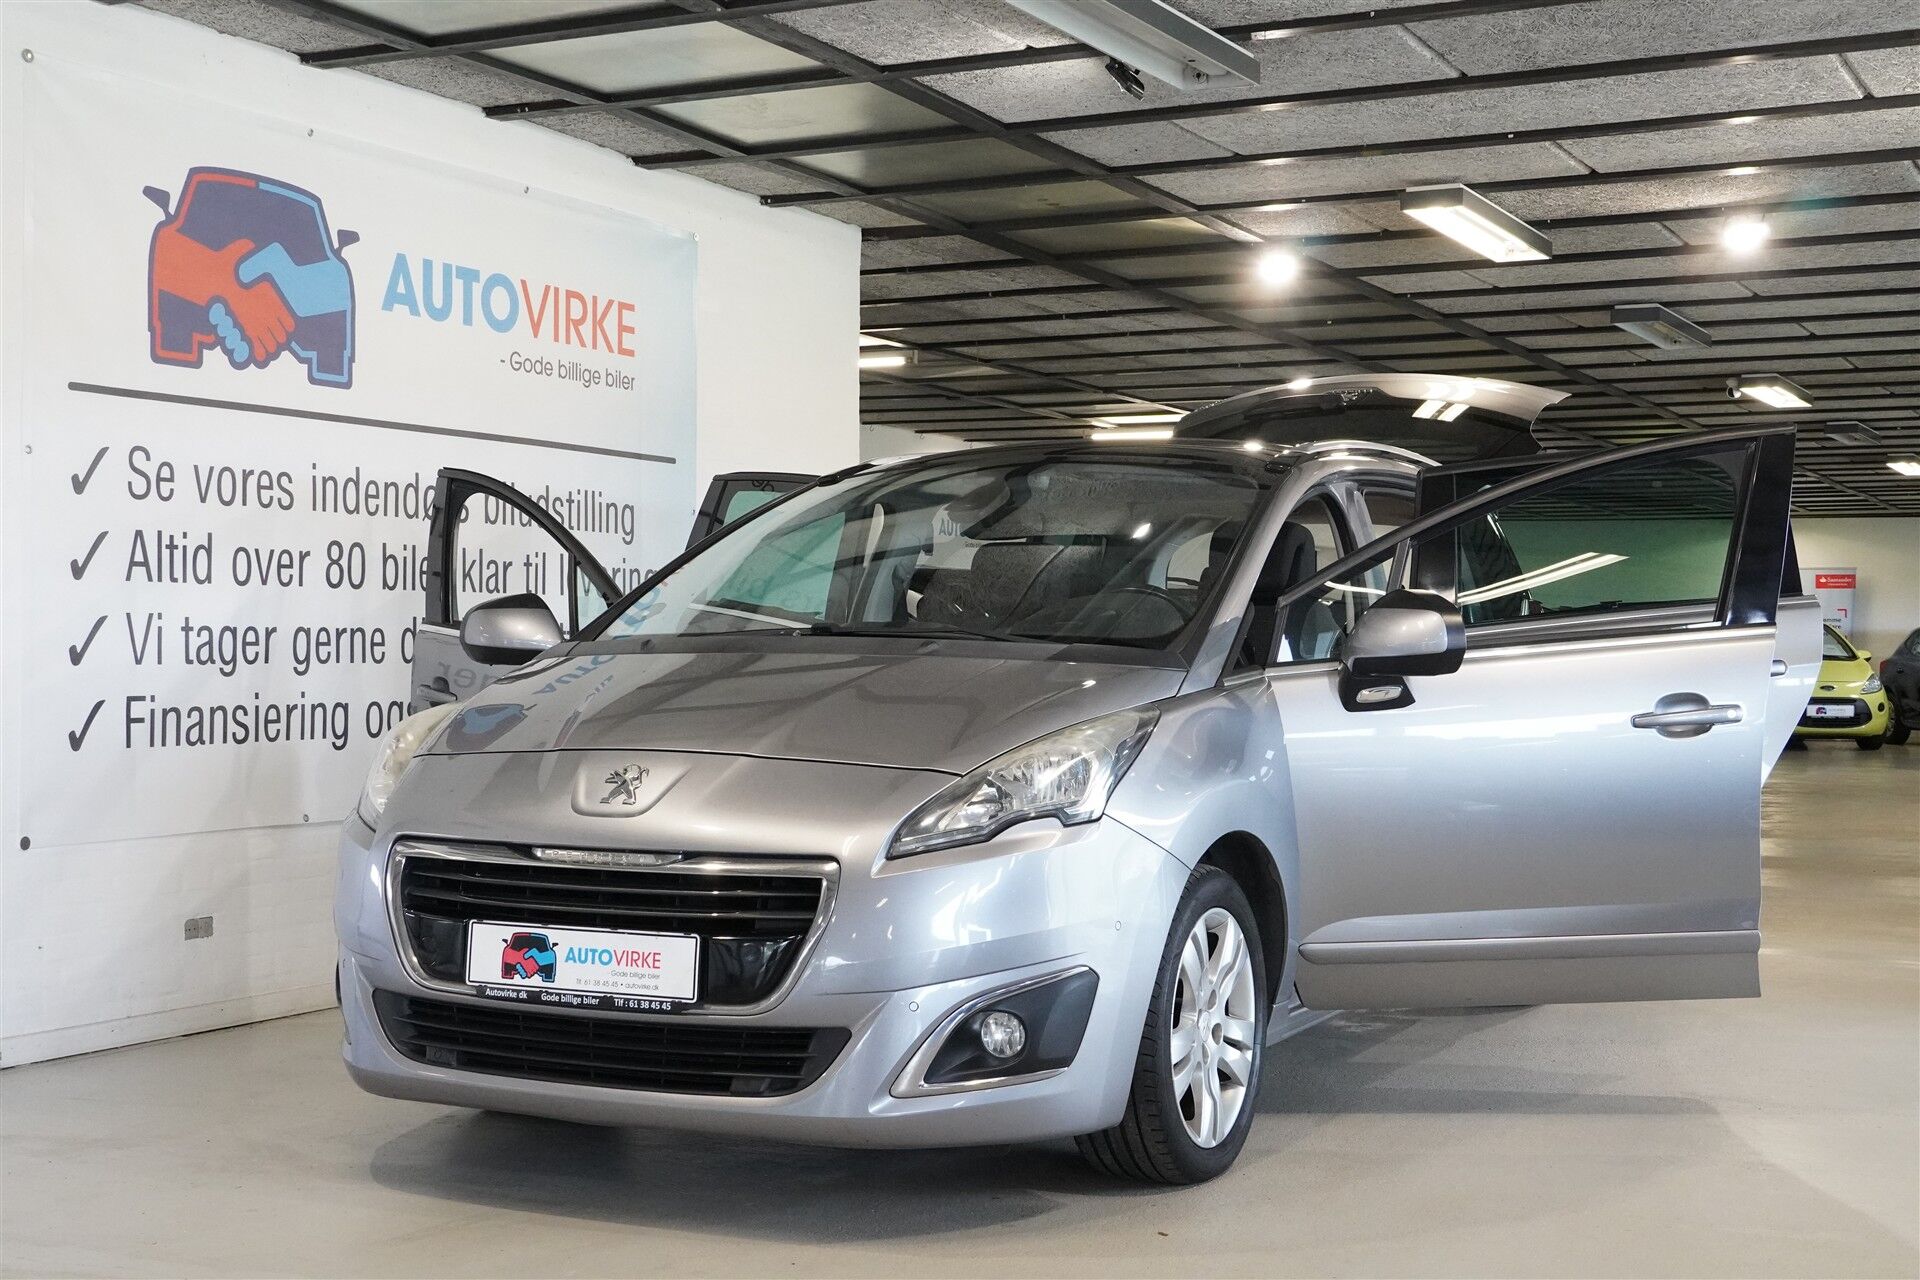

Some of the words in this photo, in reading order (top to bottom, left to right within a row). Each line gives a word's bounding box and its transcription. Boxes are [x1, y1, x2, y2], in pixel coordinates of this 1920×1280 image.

[381, 252, 635, 358] AUTOVIRKE
[509, 351, 553, 378] Gode
[558, 358, 601, 388] billige
[605, 368, 636, 391] biler
[127, 445, 175, 502] Se
[193, 464, 295, 511] vores
[312, 462, 470, 523] indendøs
[125, 529, 212, 585] Altid
[232, 546, 311, 588] over
[325, 540, 366, 590] 80
[382, 542, 427, 592] bile
[462, 547, 513, 594] klar
[523, 552, 546, 596] til
[126, 612, 163, 666] Vi
[180, 616, 278, 677] tager
[293, 626, 386, 676] gerne
[125, 691, 350, 751] Finansiering
[564, 946, 662, 970] AUTOVIRKE
[610, 969, 629, 979] Gode
[629, 970, 647, 981] billige
[647, 973, 661, 981] biler
[541, 992, 560, 1002] Gode
[560, 993, 582, 1005] billige
[583, 995, 600, 1006] biler
[629, 999, 639, 1009] 61
[640, 1000, 650, 1010] 38
[650, 1001, 661, 1010] 45
[661, 1002, 672, 1011] 45
[583, 978, 591, 986] 61
[601, 979, 609, 988] 45
[610, 980, 619, 989] 45
